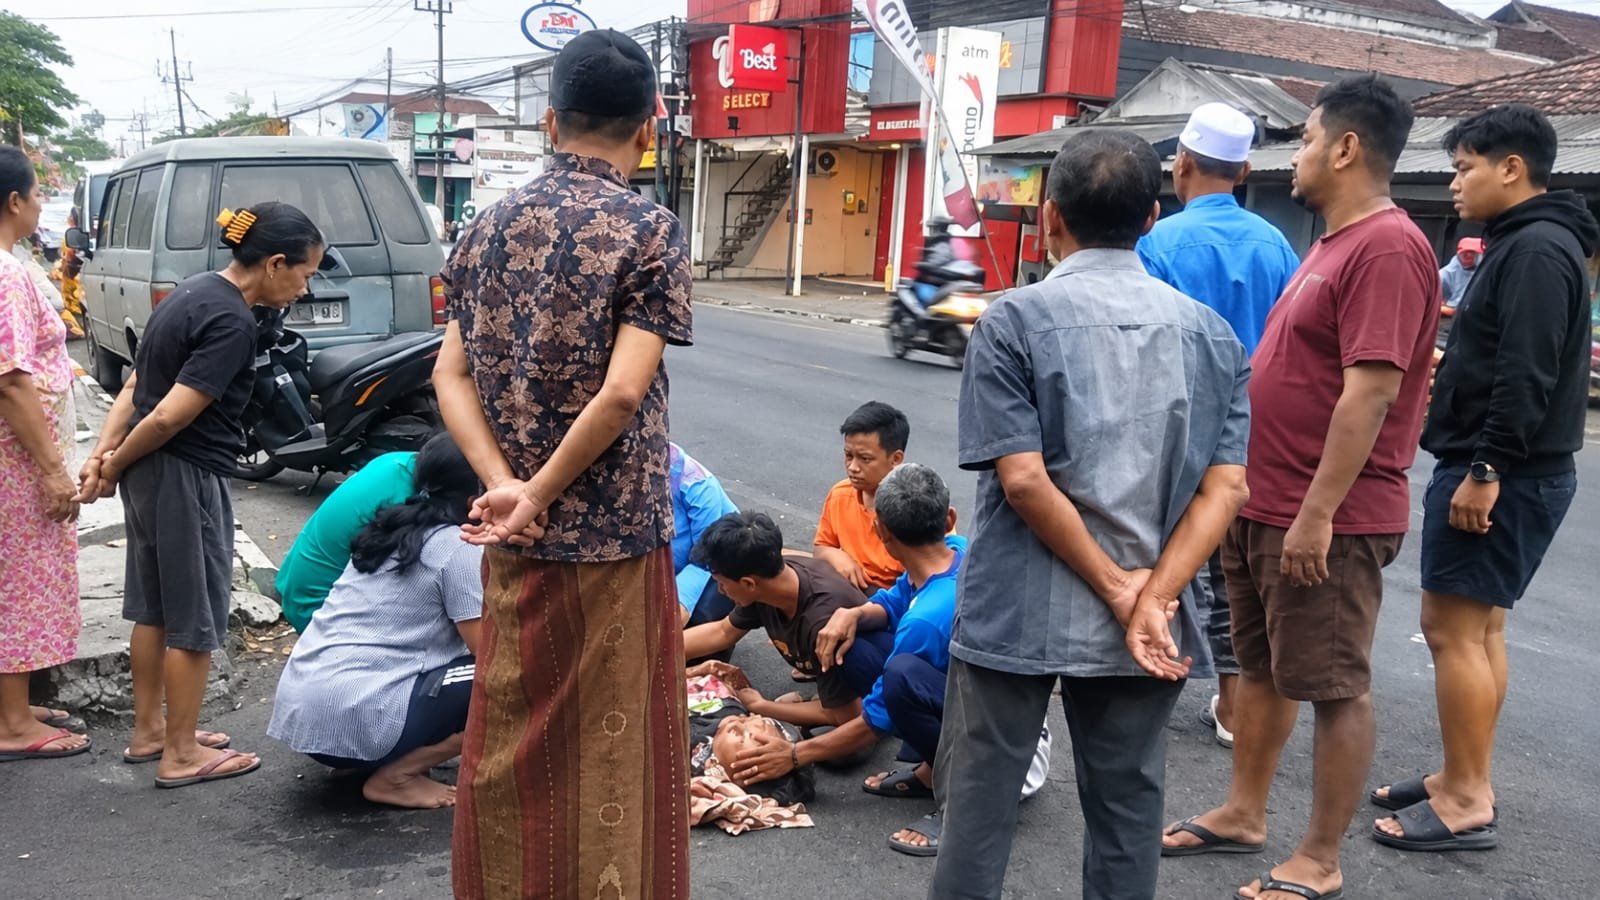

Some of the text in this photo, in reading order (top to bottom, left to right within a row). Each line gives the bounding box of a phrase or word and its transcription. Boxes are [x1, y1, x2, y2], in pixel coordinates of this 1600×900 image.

[739, 49, 777, 70] Best
[961, 45, 989, 59] atm
[723, 92, 770, 110] SELECT
